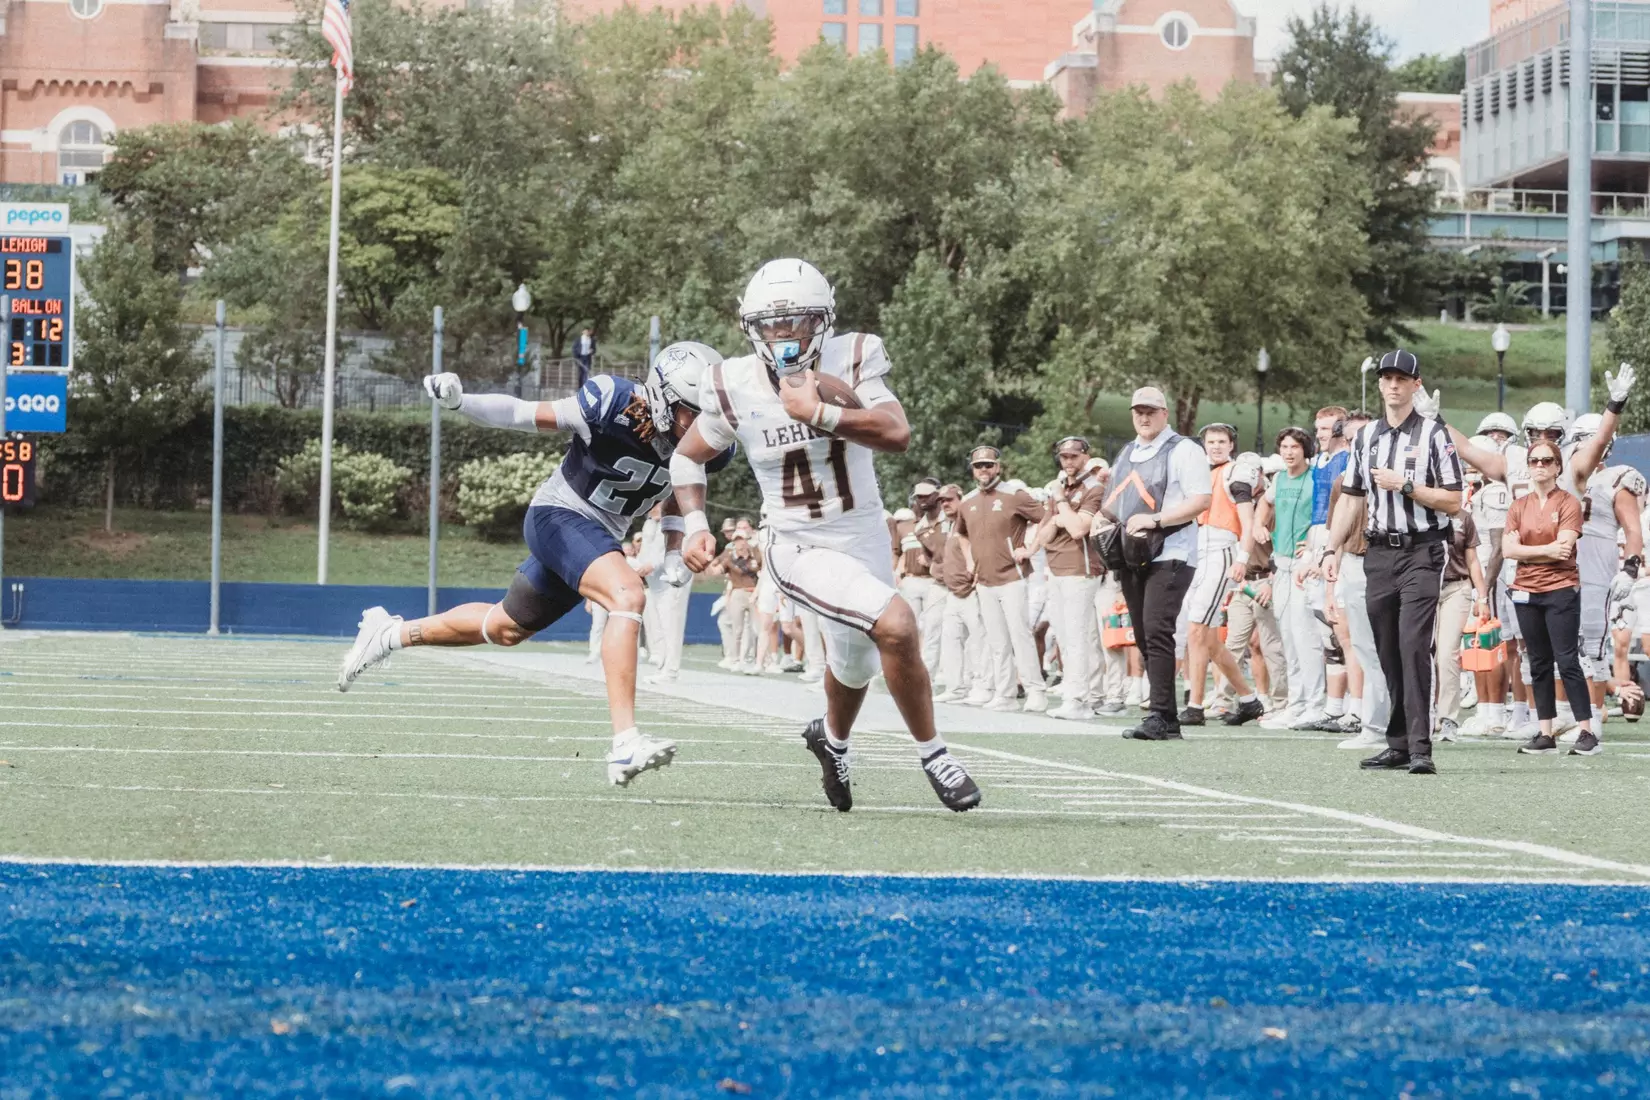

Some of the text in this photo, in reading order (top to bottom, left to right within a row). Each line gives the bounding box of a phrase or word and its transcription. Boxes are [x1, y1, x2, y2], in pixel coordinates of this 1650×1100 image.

[7, 209, 62, 225] pepco
[1, 237, 48, 252] LEHIGH
[6, 259, 43, 289] 38
[11, 298, 62, 314] BALL ON
[18, 394, 60, 413] QQQ
[762, 423, 822, 448] LEHI
[3, 464, 23, 500] 0
[780, 439, 855, 519] 41
